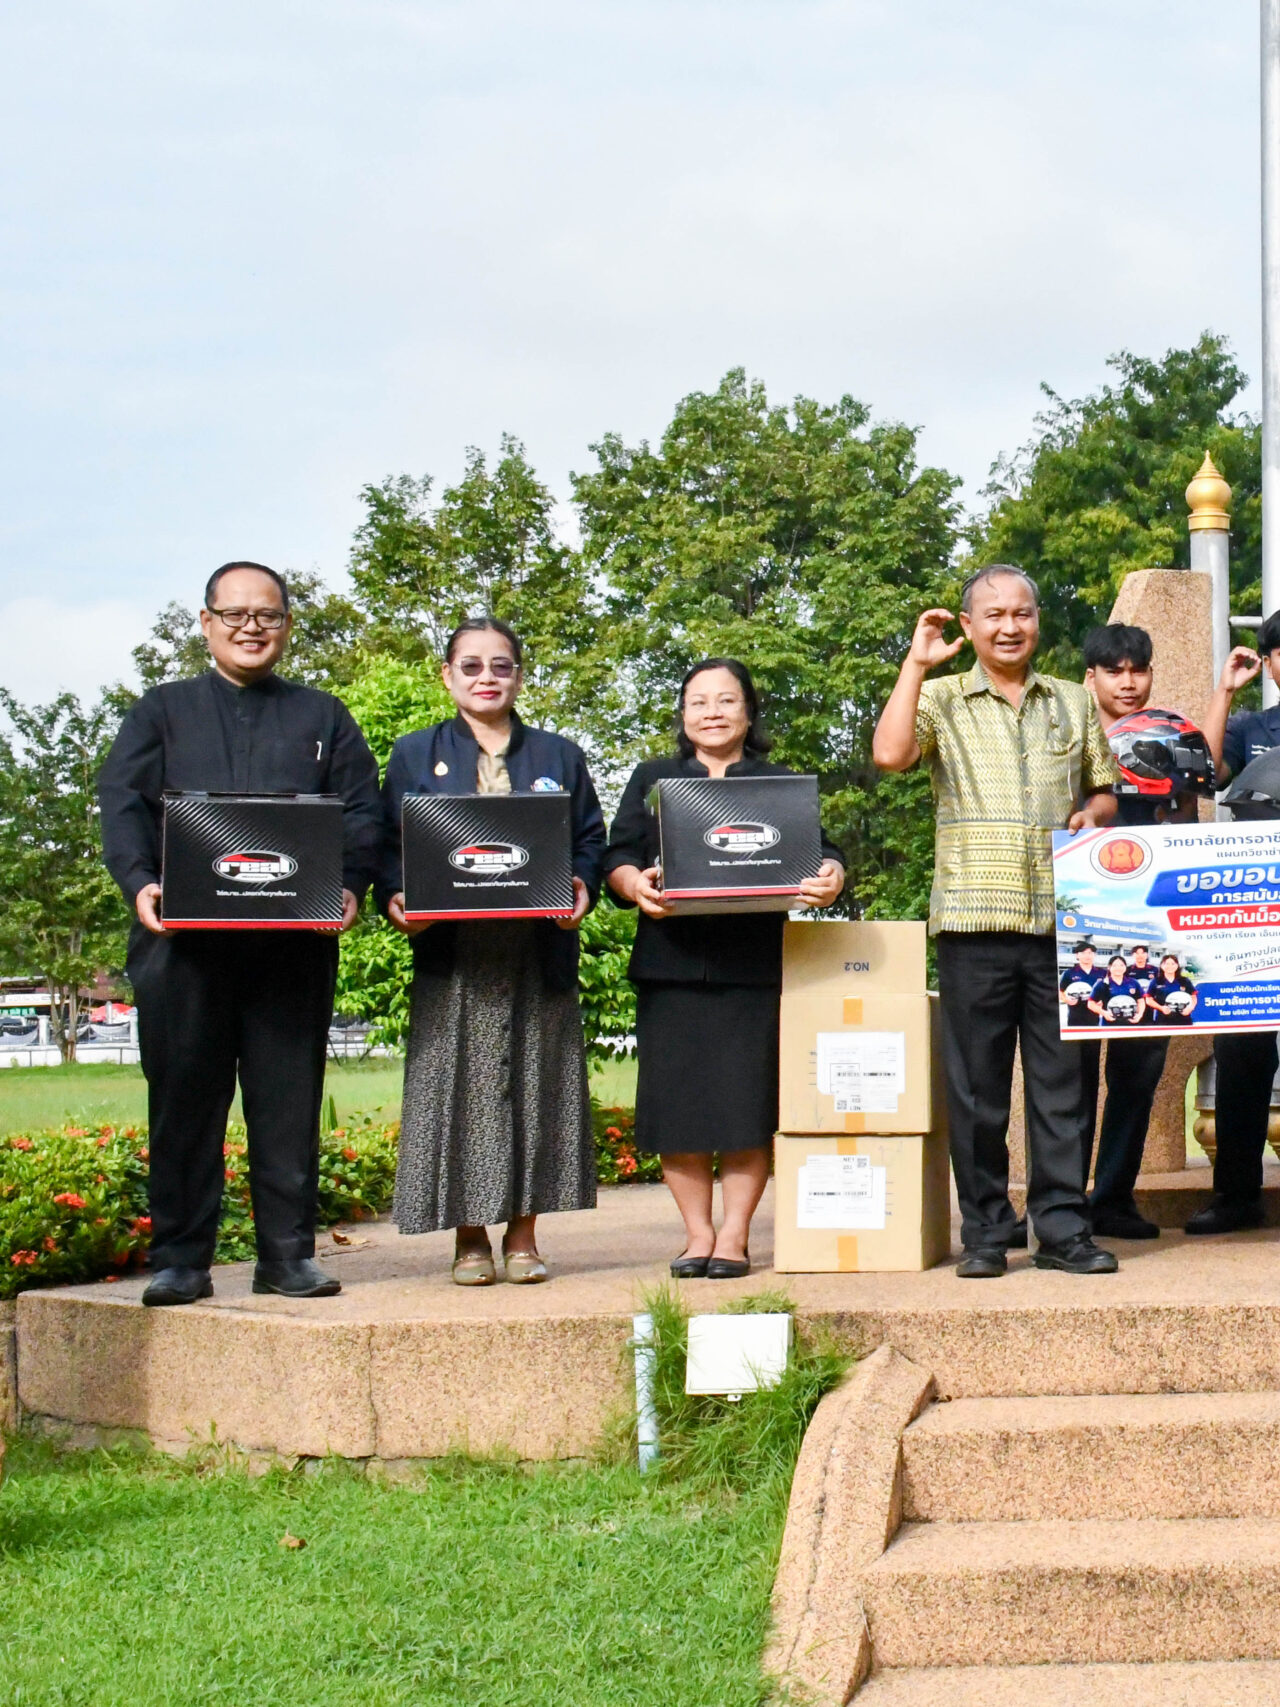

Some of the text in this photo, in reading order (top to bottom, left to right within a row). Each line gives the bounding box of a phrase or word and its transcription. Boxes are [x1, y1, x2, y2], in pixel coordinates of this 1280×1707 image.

[1206, 932, 1232, 940] บริษัท
[844, 962, 870, 972] NO.2
